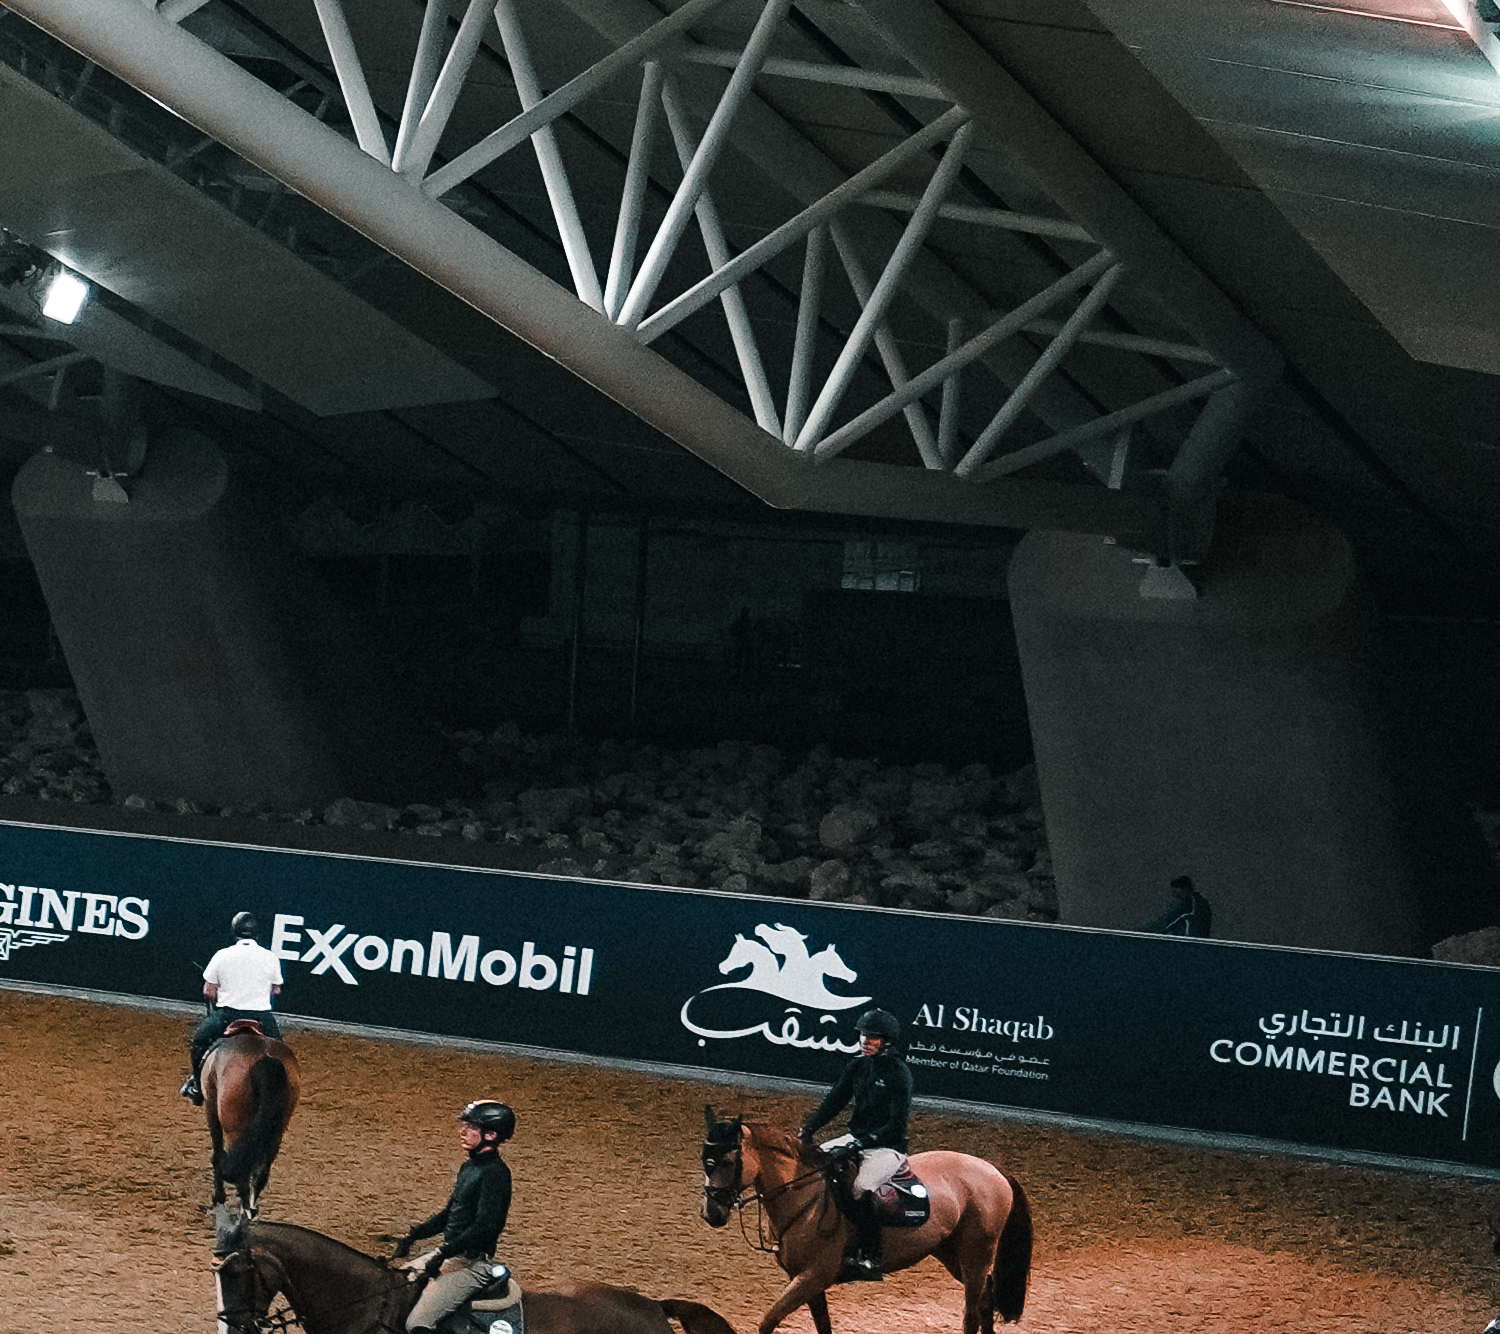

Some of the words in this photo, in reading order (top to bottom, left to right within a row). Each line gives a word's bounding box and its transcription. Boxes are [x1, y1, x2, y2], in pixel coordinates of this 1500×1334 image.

[270, 913, 594, 996] ExxonMobil
[911, 1003, 945, 1029] Al
[952, 1006, 1054, 1043] Shaqab
[1258, 1009, 1366, 1041] التجاري
[1373, 1020, 1460, 1053] البنك
[905, 1054, 948, 1068] Member
[949, 1061, 959, 1070] of
[961, 1060, 989, 1073] Qatar
[991, 1064, 1049, 1081] Foundation
[1209, 1038, 1453, 1088] COMMERCIAL
[1349, 1082, 1451, 1117] BANK
